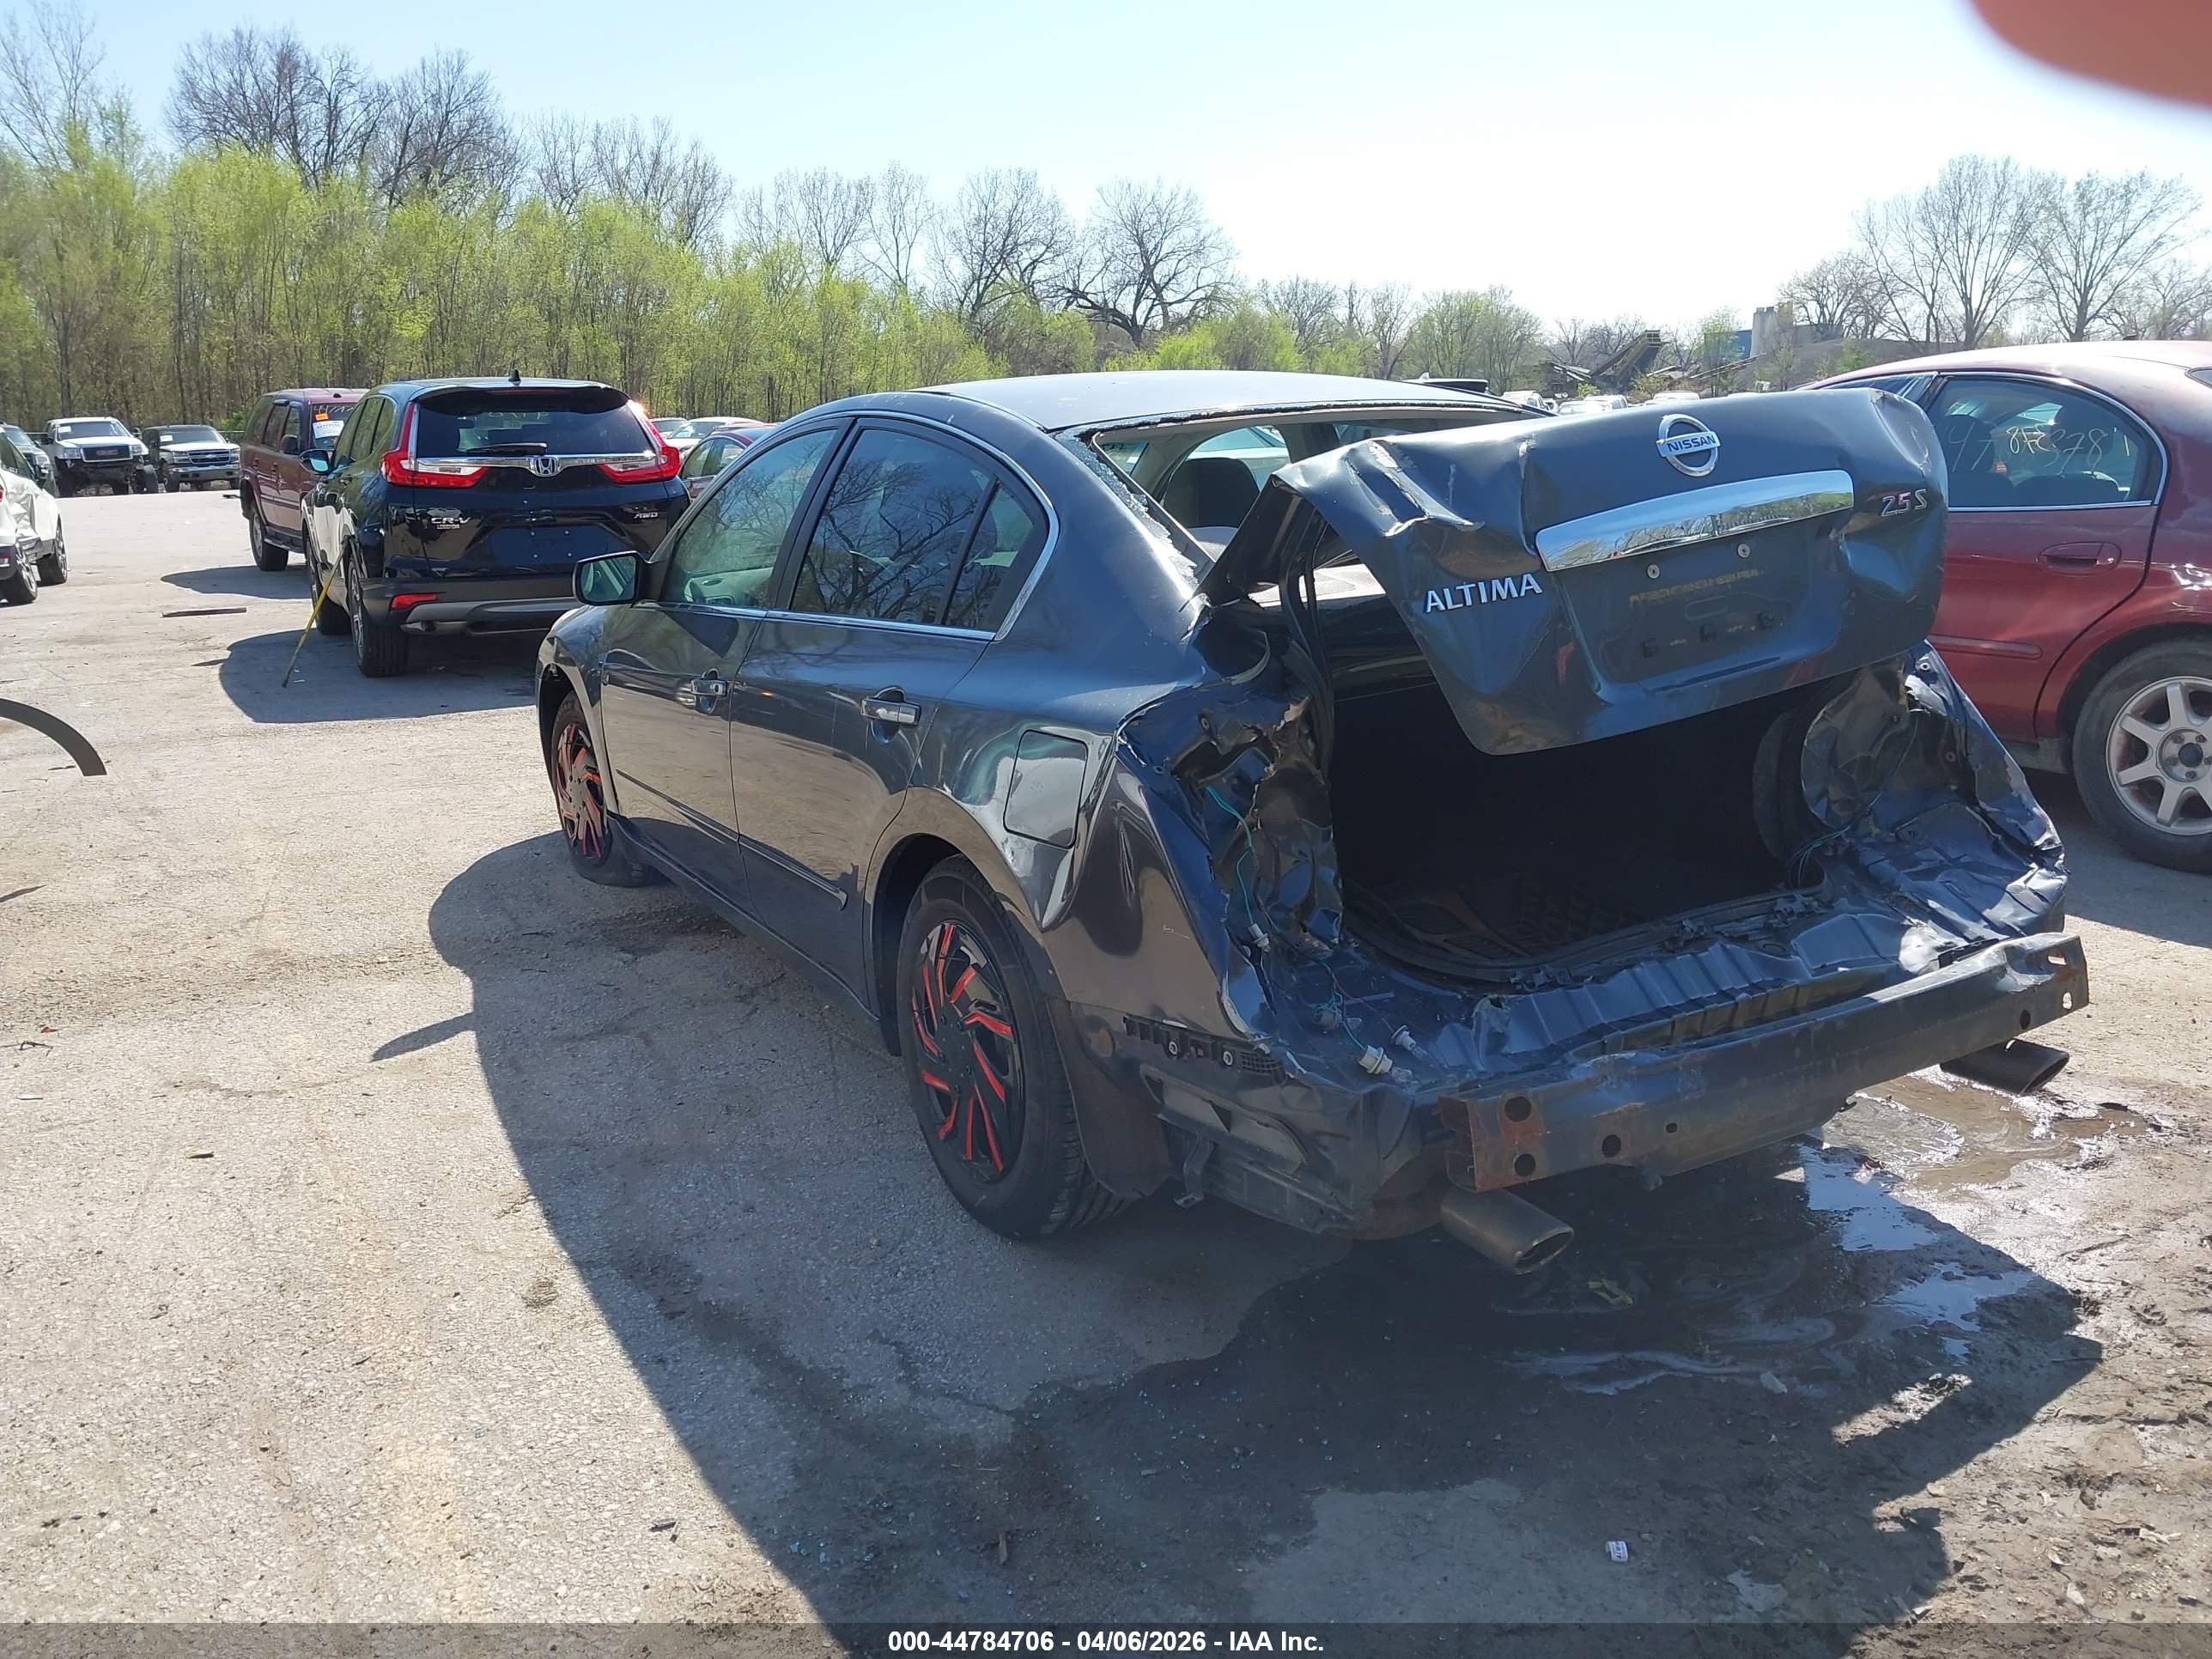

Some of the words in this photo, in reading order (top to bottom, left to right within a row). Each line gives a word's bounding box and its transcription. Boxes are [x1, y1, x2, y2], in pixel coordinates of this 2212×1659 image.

[1667, 434, 1717, 453] NISSAN
[1915, 489, 1928, 510] S
[1425, 573, 1544, 613] ALTIMA
